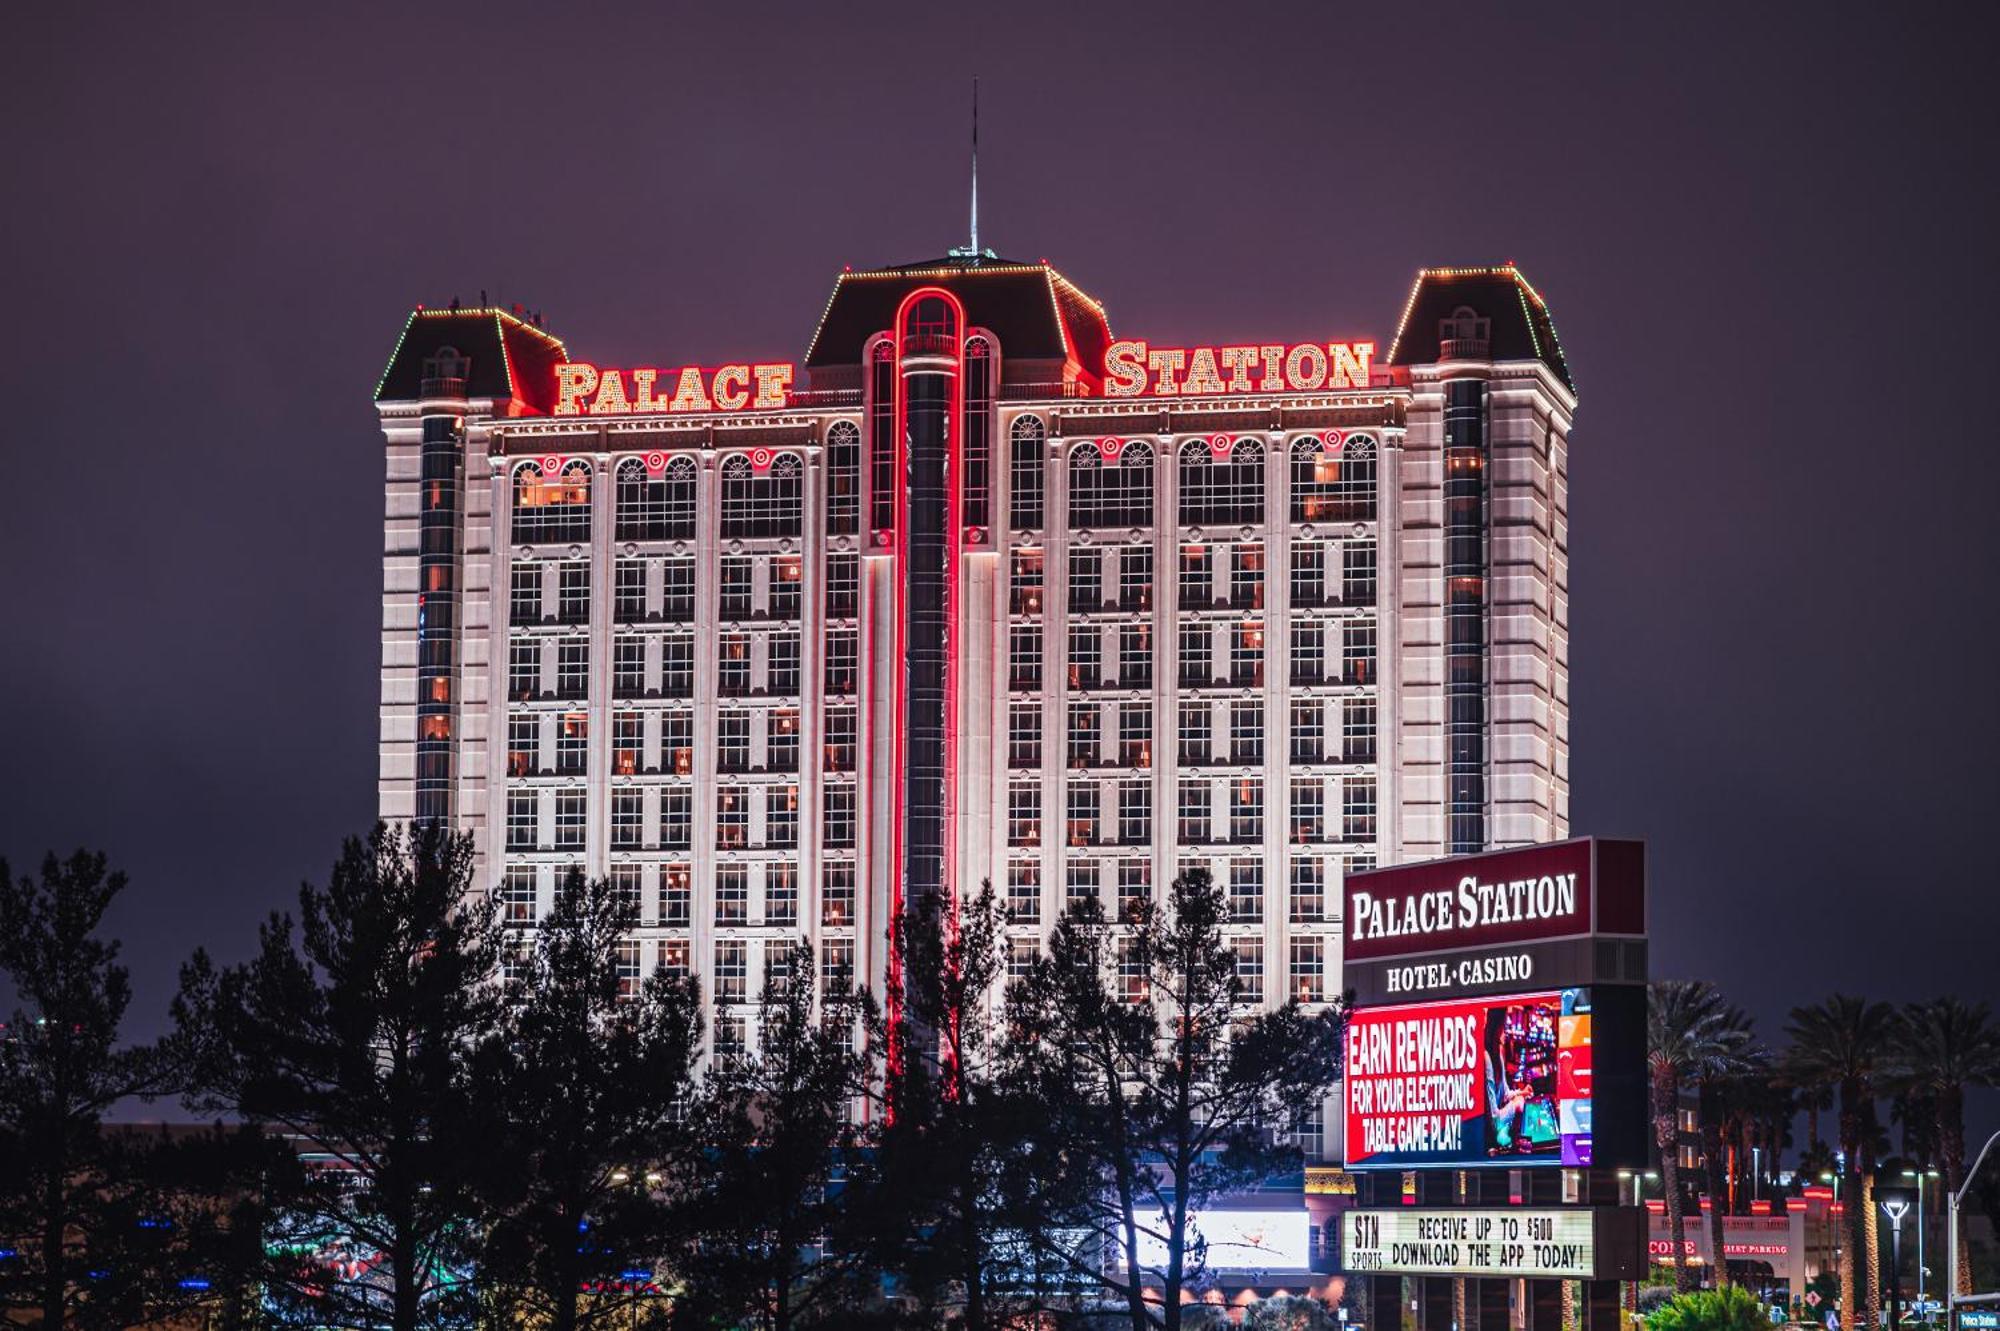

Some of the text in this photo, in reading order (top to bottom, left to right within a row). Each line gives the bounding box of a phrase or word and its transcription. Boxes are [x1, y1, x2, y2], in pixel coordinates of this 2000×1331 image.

[554, 341, 1374, 415] PALACE STATION
[1352, 874, 1576, 940] PALACE STATION
[1349, 1015, 1477, 1076] EARN REWARDS
[1351, 1073, 1475, 1114] FOR YOUR ELECTRONIC
[1363, 1114, 1462, 1153] TABLE GAME PLAY!
[1355, 1215, 1379, 1249] STN
[1418, 1217, 1553, 1241] RECEIVE UP TO $500
[1351, 1252, 1382, 1270] SPORTS
[1392, 1243, 1584, 1270] DOWNLOAD THE APP TODAY!
[1748, 1245, 1787, 1254] PARKING
